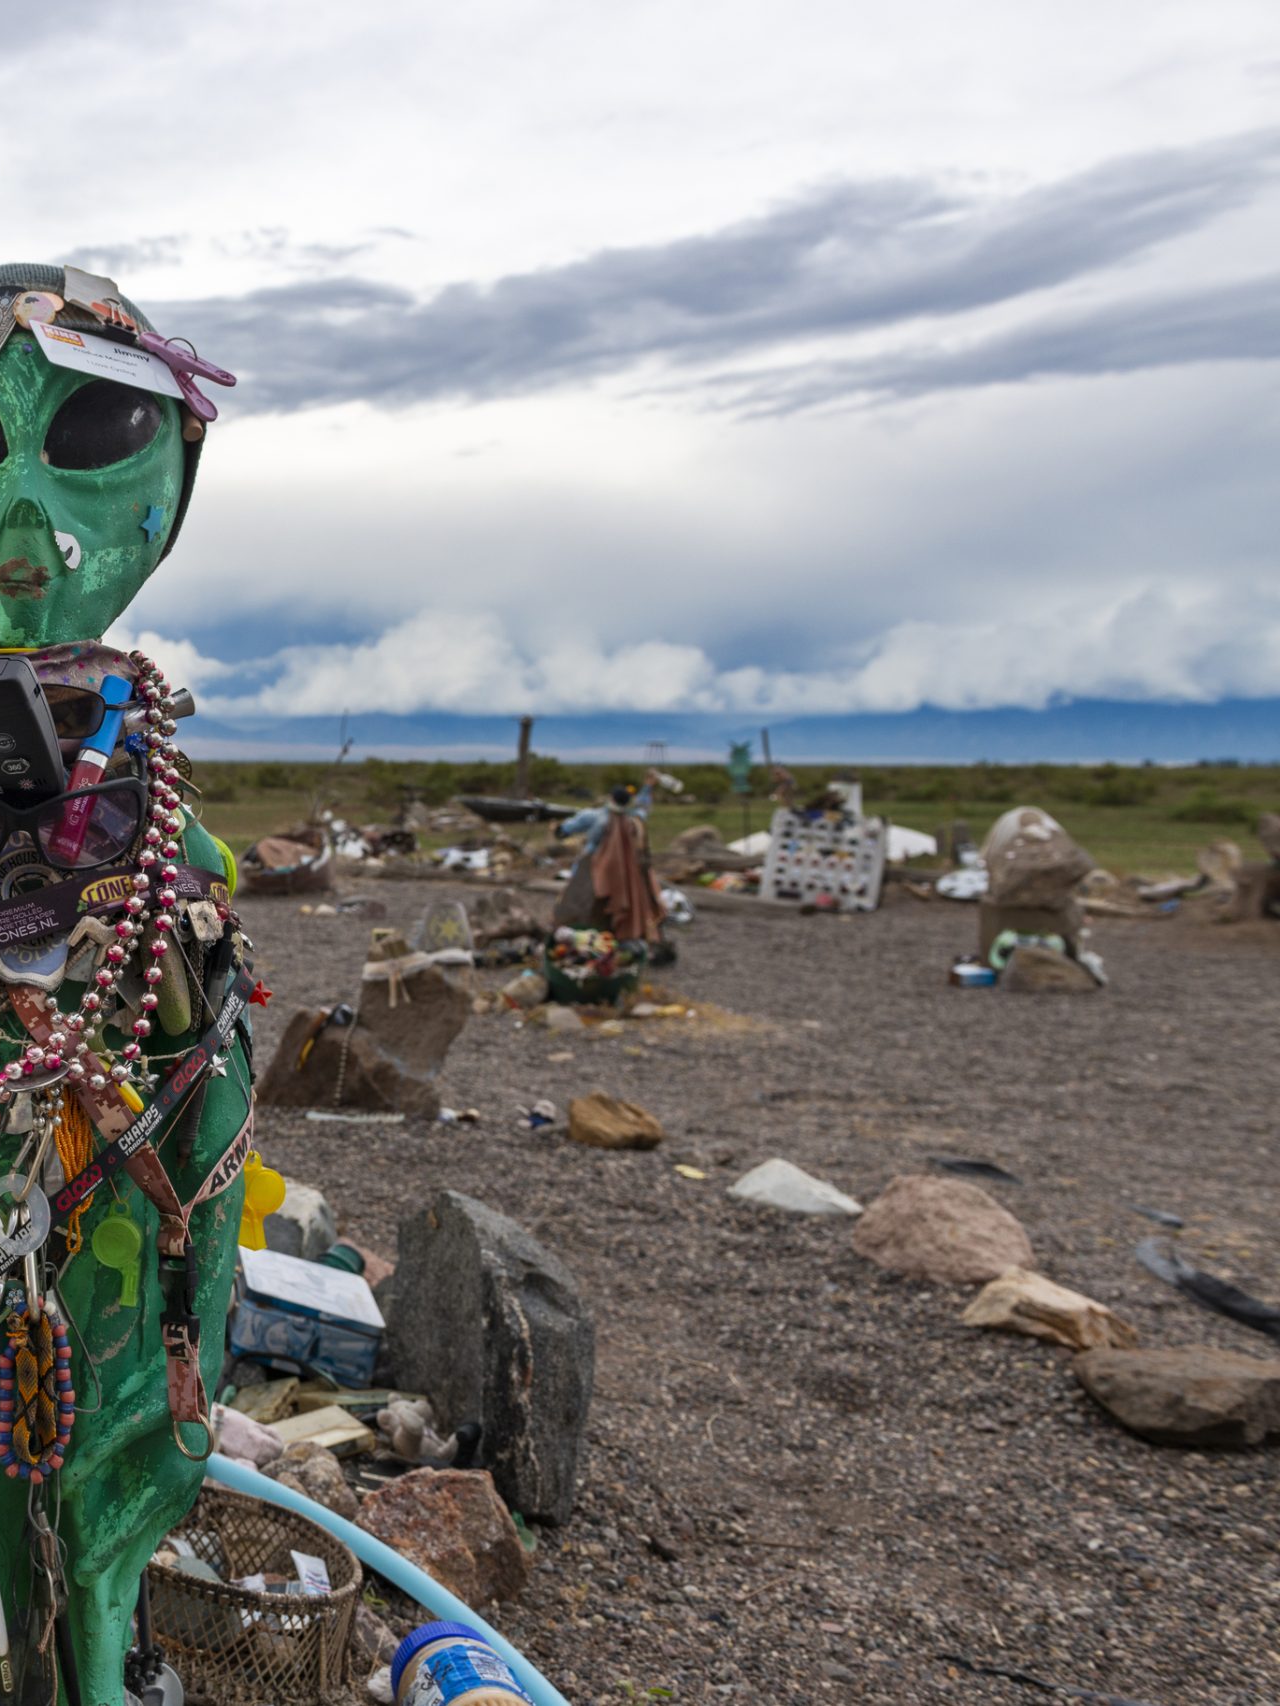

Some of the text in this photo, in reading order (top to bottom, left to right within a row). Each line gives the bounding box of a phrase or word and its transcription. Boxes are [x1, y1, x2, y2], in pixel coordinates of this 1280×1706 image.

[113, 347, 150, 363] Jimmy
[28, 909, 56, 922] PAPER
[217, 991, 240, 1034] CHAMPS
[118, 1104, 160, 1151] CHAMPS
